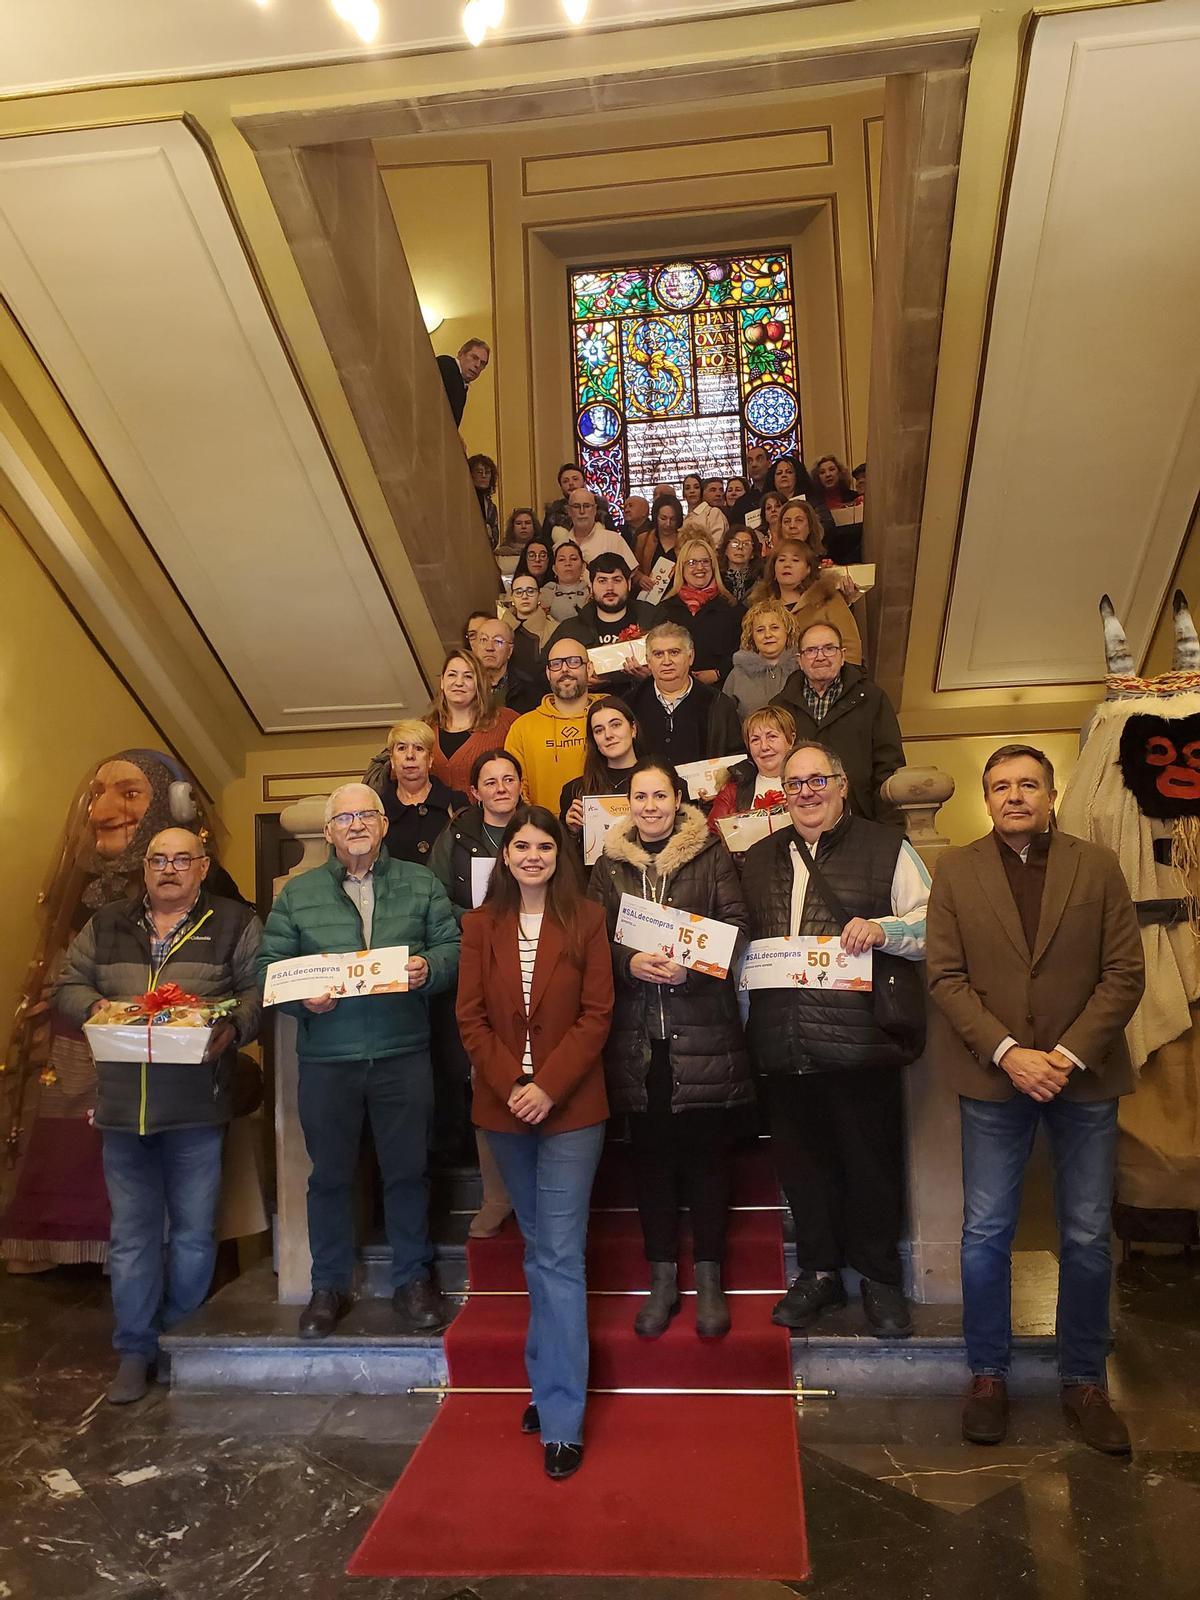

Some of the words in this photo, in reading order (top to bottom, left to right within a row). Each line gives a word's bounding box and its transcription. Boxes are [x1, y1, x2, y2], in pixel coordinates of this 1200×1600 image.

[696, 351, 737, 367] TOS
[546, 738, 584, 748] SUMM
[622, 907, 674, 930] #SALdecompras
[678, 927, 694, 945] 15
[697, 934, 709, 949] €
[745, 951, 802, 961] #SALdecompras
[807, 951, 831, 967] 50
[835, 953, 849, 968] €
[271, 966, 341, 980] #SALdecompras
[346, 964, 365, 979] 10
[369, 962, 382, 975] €
